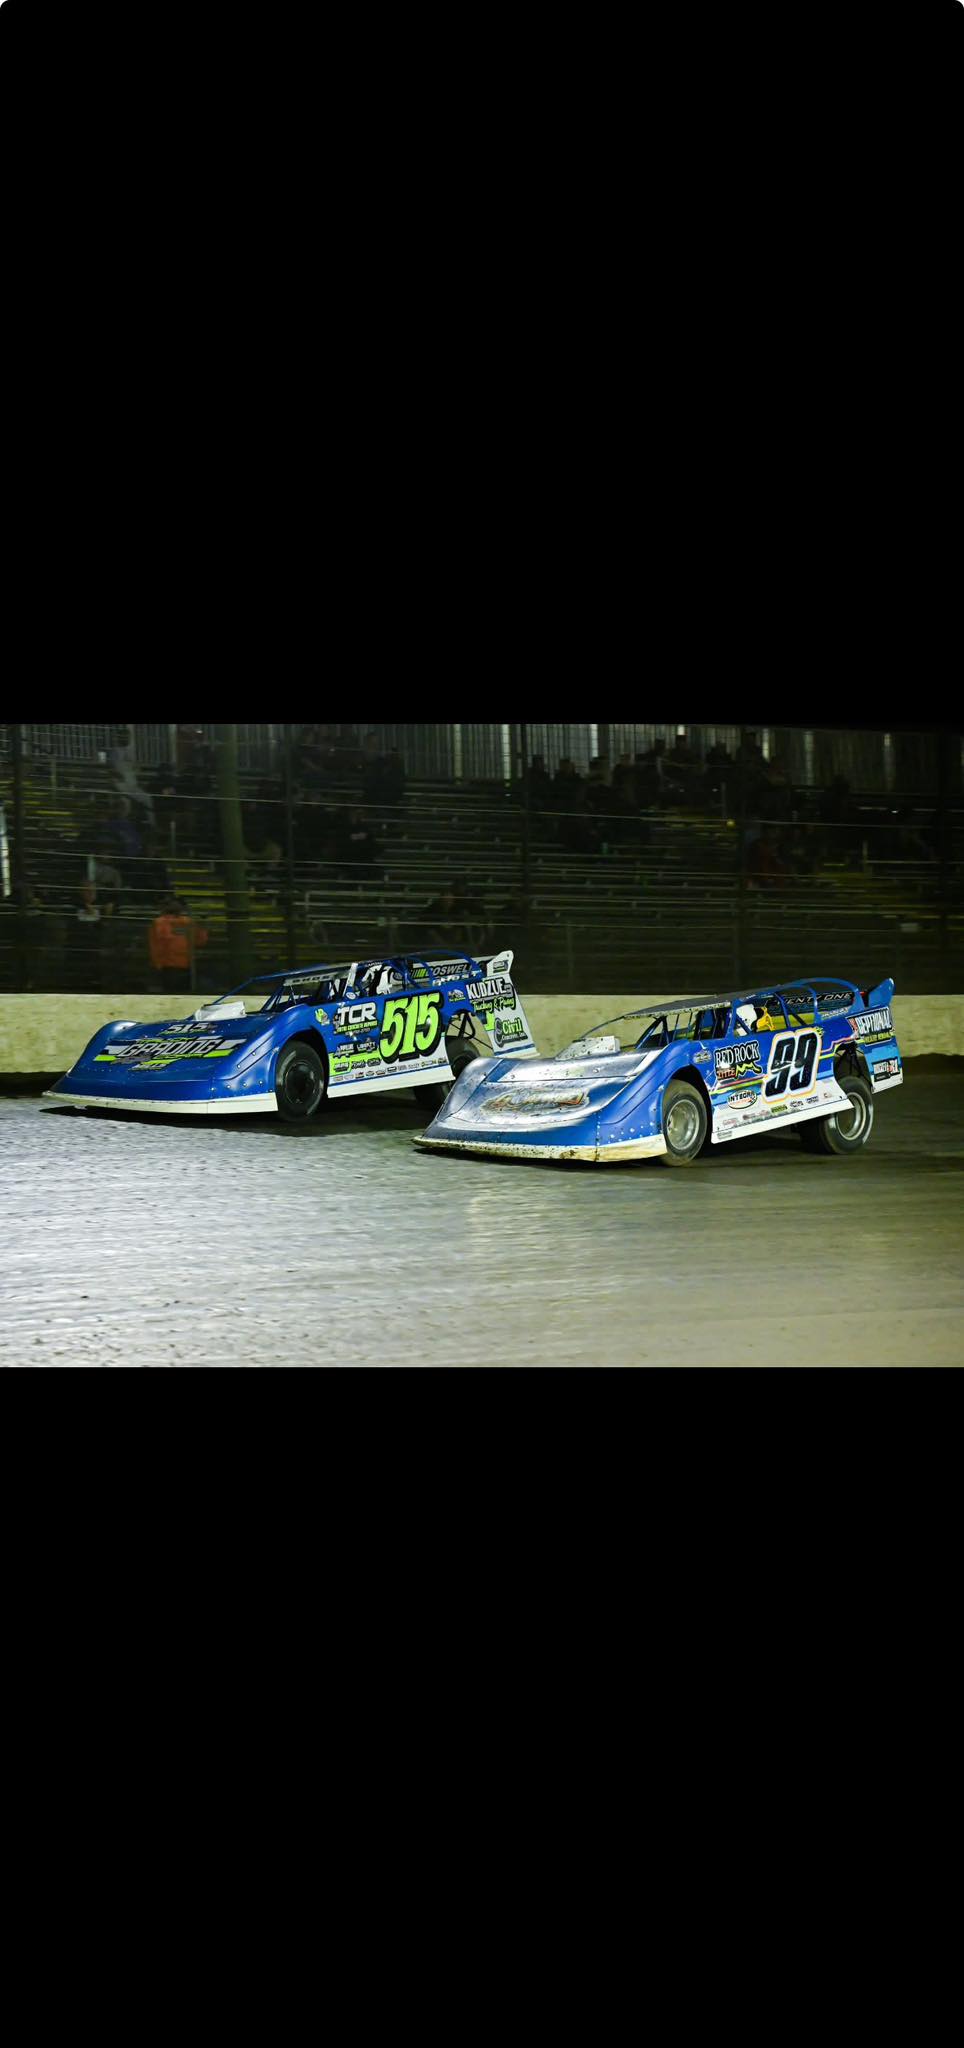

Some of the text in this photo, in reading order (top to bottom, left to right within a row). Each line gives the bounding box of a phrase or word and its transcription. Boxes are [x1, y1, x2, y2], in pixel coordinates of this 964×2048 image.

[337, 1002, 376, 1025] TCR
[380, 992, 440, 1058] 515
[166, 1022, 209, 1033] 515
[502, 1018, 522, 1035] Civil
[117, 1039, 221, 1057] GRADING
[715, 1050, 734, 1067] RED
[734, 1043, 759, 1063] ROCK
[765, 1032, 819, 1097] 99
